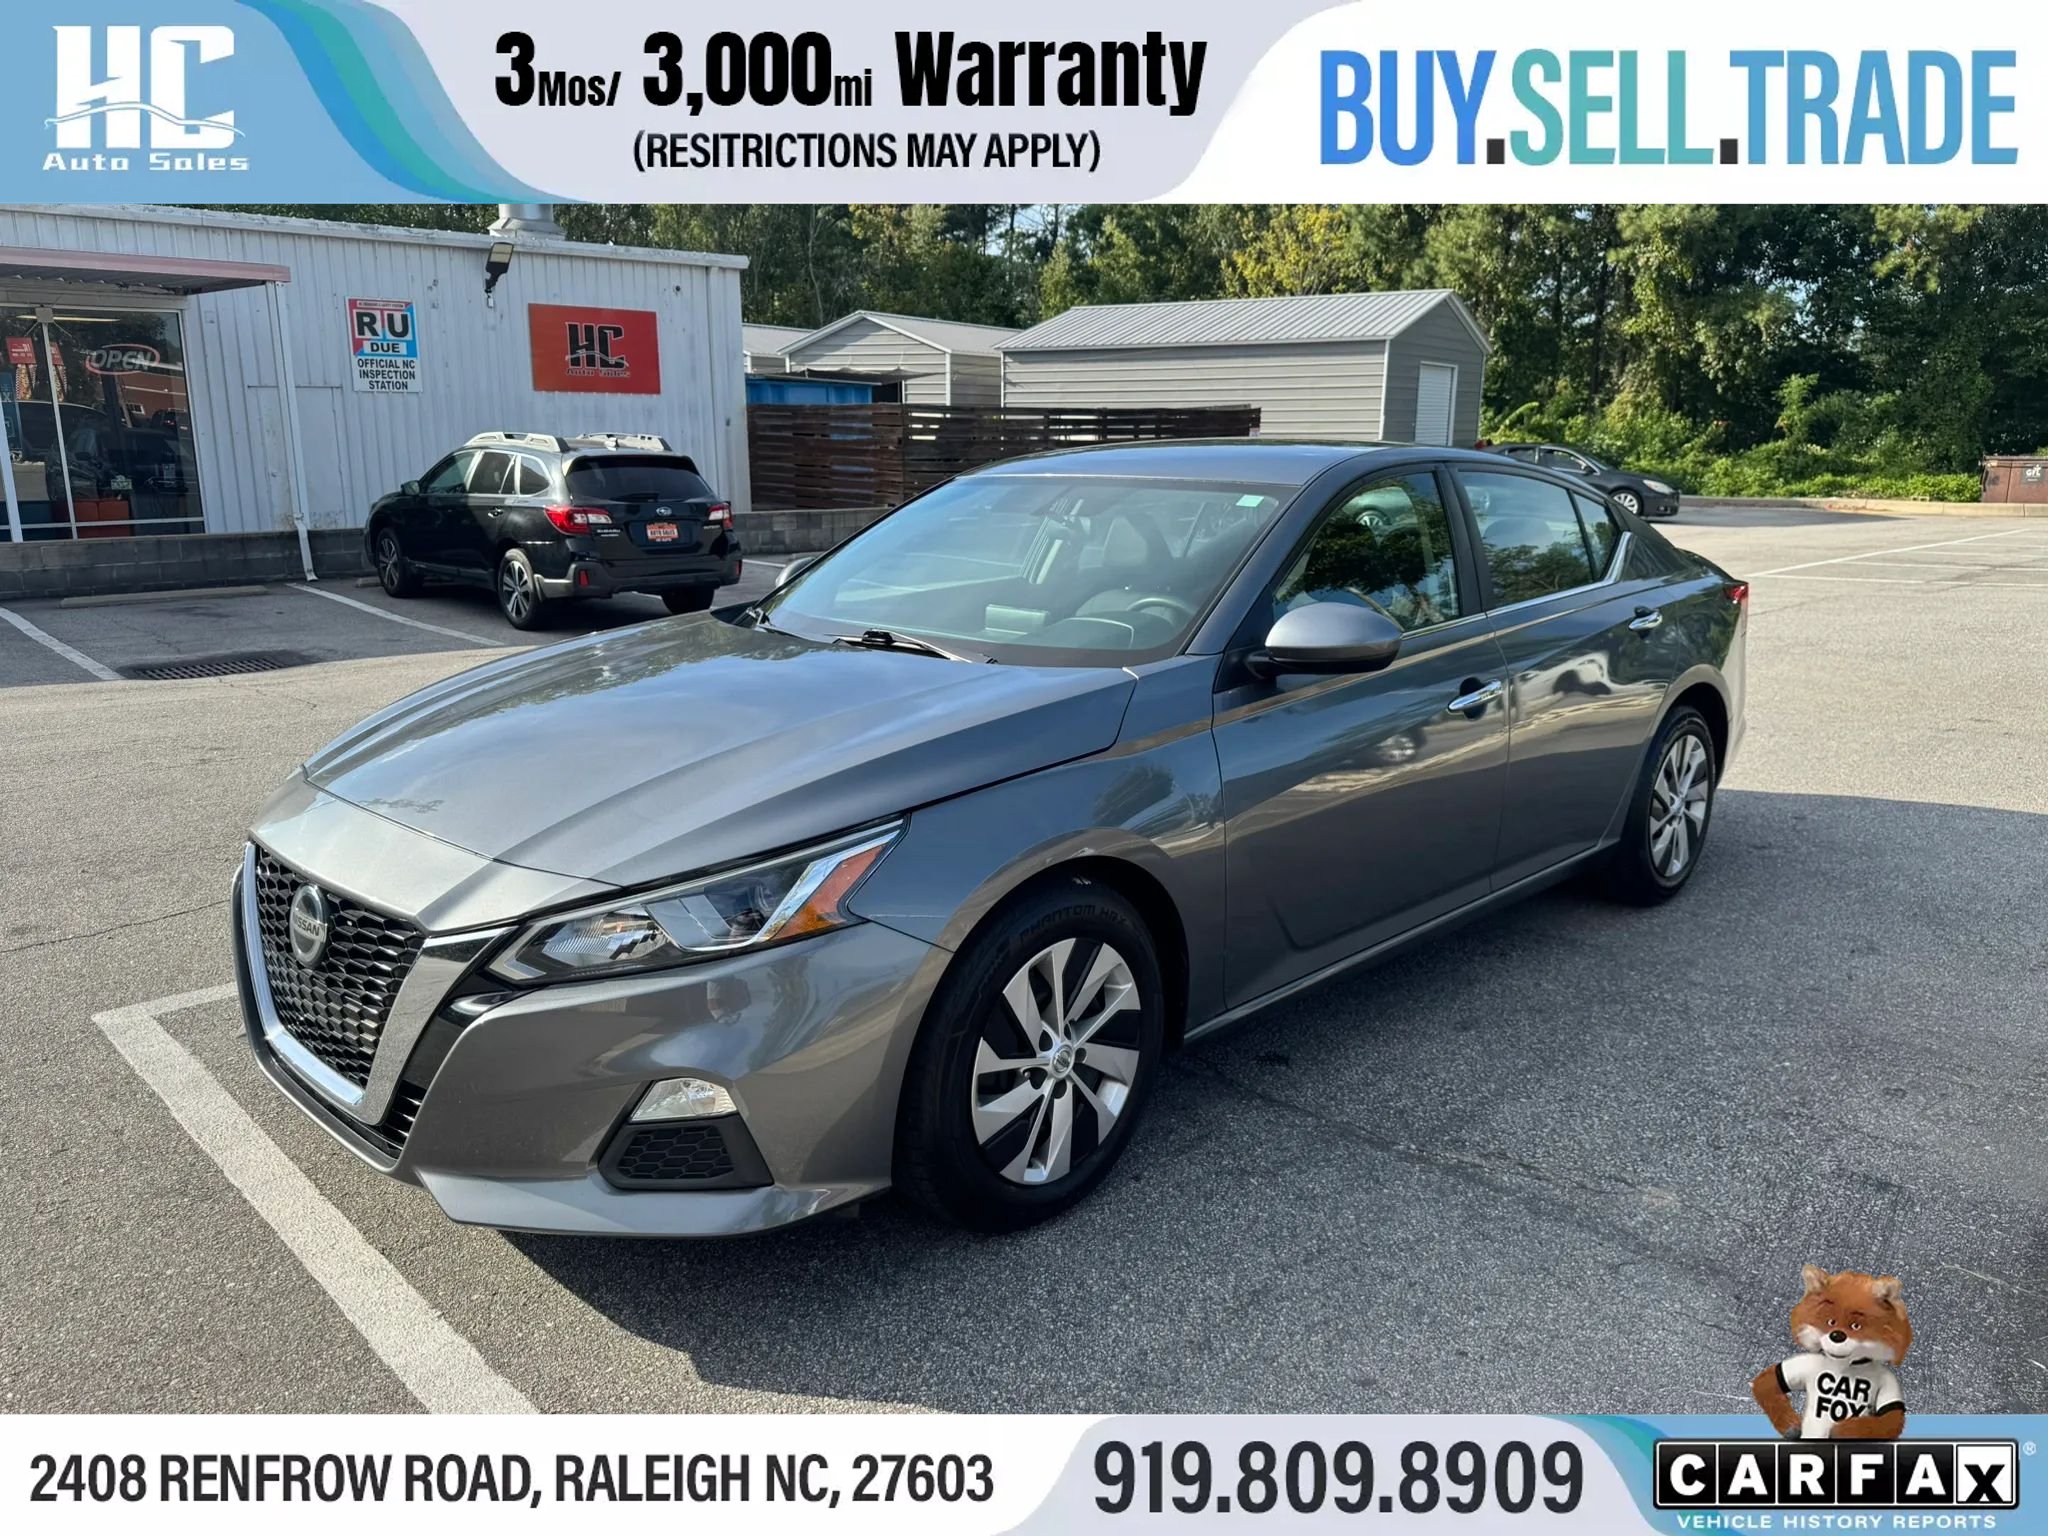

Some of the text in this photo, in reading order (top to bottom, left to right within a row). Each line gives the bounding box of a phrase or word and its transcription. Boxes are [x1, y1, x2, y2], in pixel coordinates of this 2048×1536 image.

[370, 342, 400, 353] DUE
[566, 323, 625, 369] HC
[91, 349, 152, 371] OPEN
[357, 359, 416, 369] OFFICIAL NC
[359, 369, 416, 380] INSPECTION
[369, 381, 408, 390] STATION
